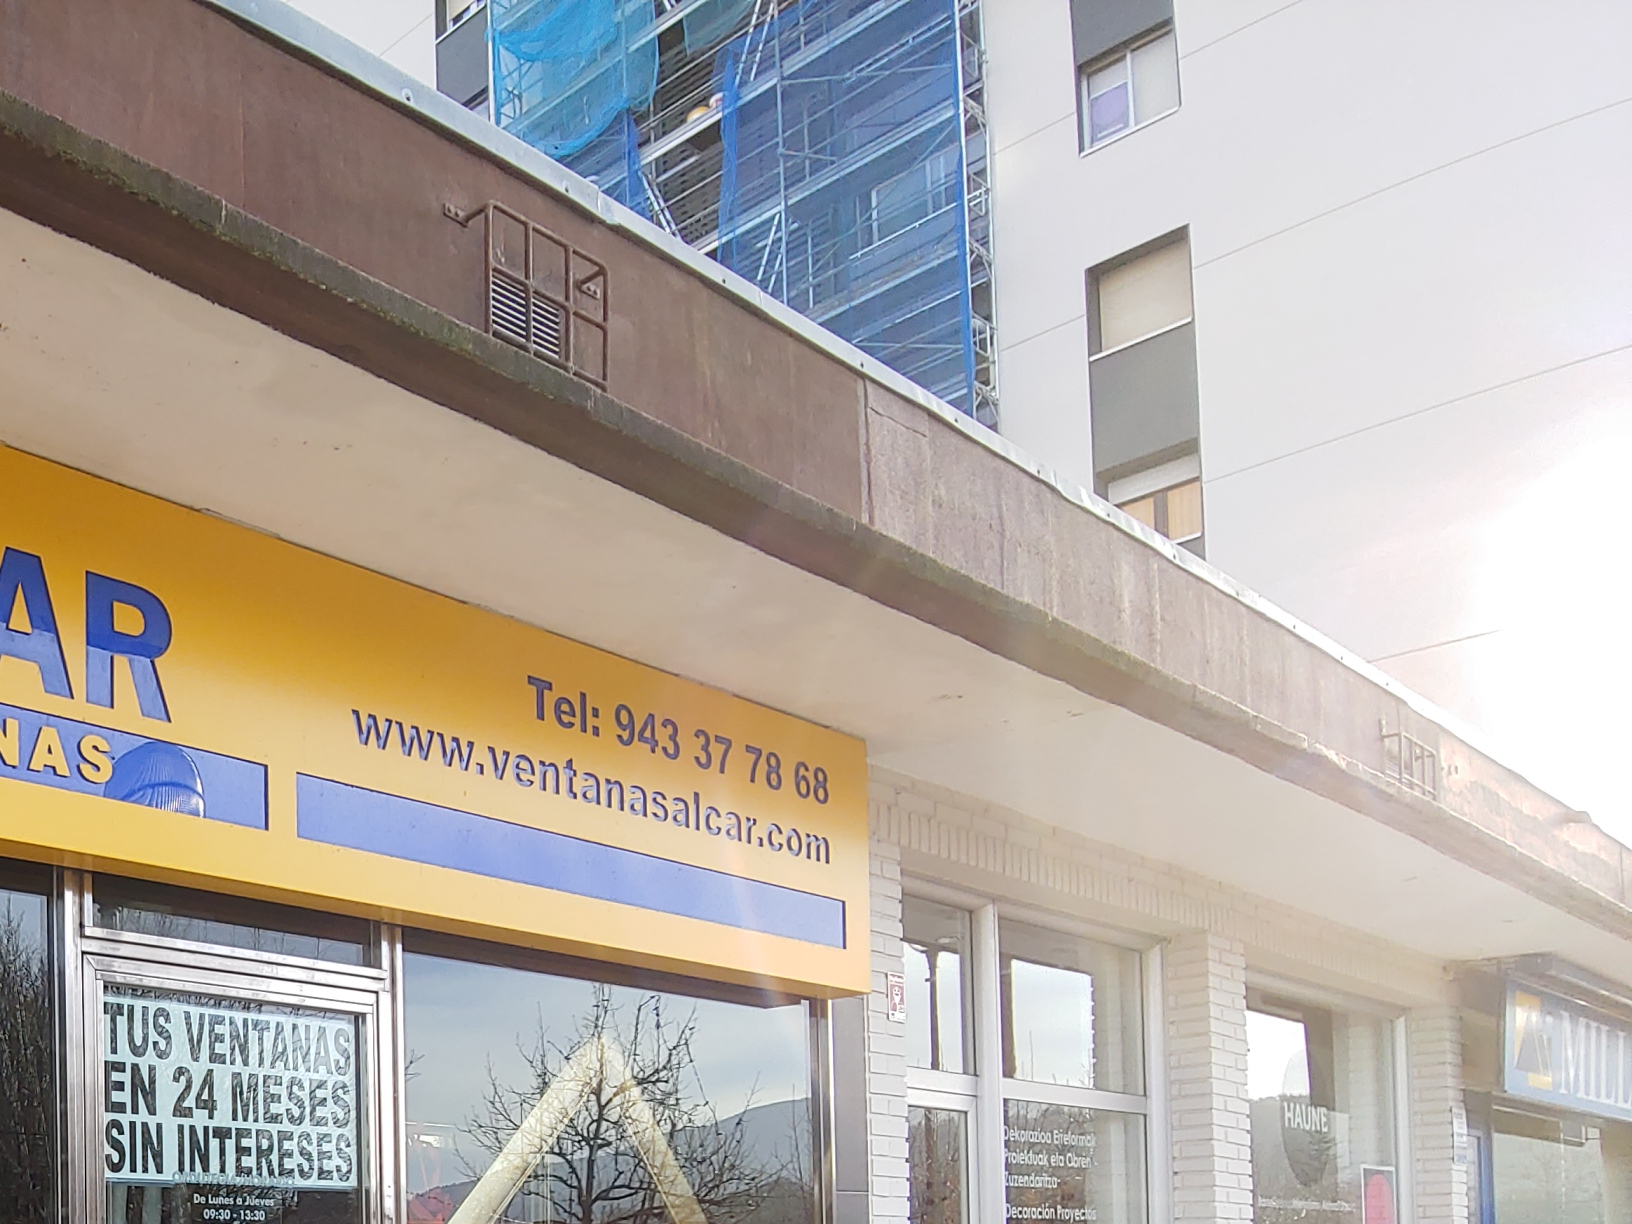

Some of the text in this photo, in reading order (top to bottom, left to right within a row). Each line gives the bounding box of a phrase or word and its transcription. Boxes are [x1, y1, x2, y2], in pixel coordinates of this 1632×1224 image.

[526, 675, 831, 806] Tel: 943 37 78 68
[351, 708, 831, 864] www.ventanasalcar.com
[104, 1003, 351, 1077] TUS VENTANAS
[104, 1061, 351, 1129] EN 24 MESES
[1283, 1101, 1329, 1132] HAUNE
[1003, 1125, 1051, 1144] Dekorazioa
[105, 1119, 353, 1182] SIN INTERESES
[1051, 1154, 1065, 1166] eta
[1066, 1152, 1092, 1168] Obren
[193, 1194, 274, 1206] De Lunes a Jueves
[203, 1209, 230, 1219] 09:30
[239, 1210, 265, 1220] 13:30
[1006, 1203, 1098, 1223] Decoración Proyectos
